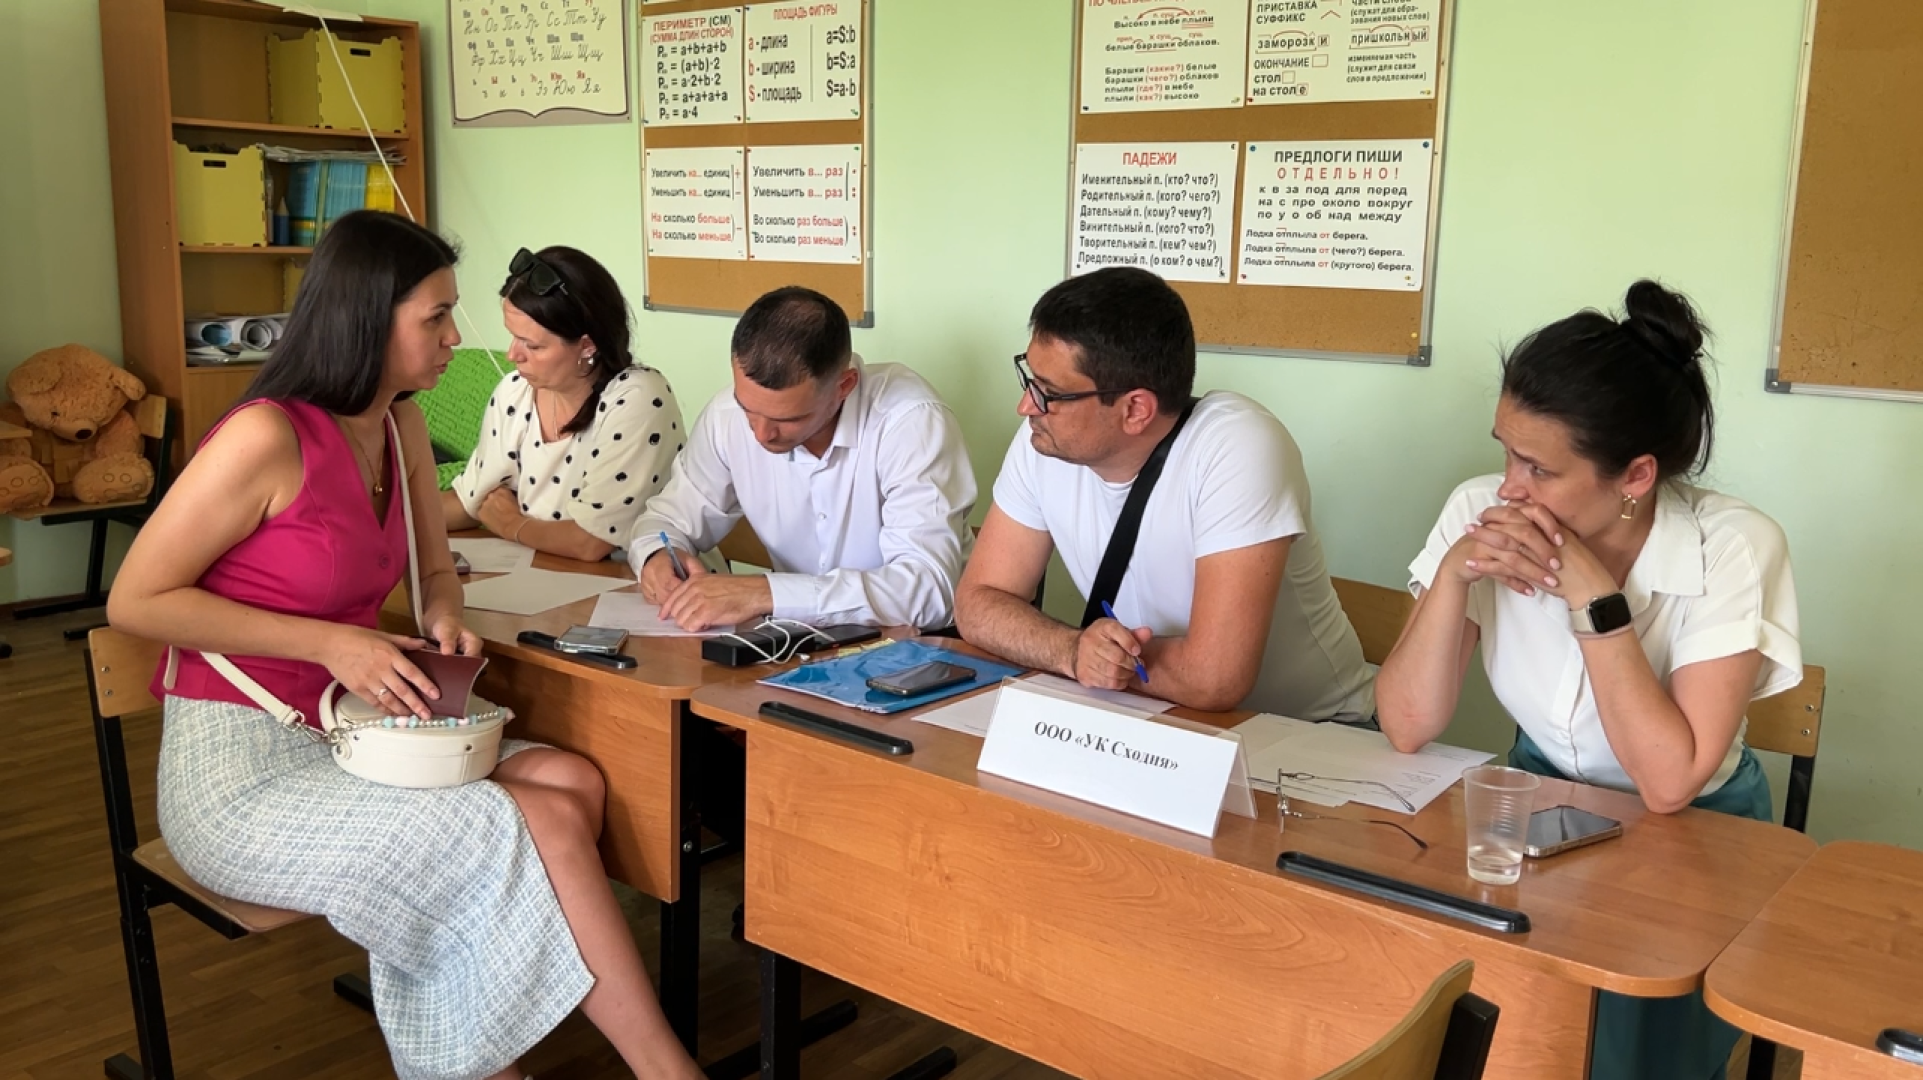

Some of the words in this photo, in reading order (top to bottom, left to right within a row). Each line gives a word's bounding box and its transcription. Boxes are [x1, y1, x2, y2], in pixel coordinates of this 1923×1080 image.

[774, 9, 807, 20] ПЛОЩАДЬ
[810, 4, 837, 16] ФИГУРЫ
[1257, 1, 1317, 12] ПРИСТАВКА
[654, 18, 706, 31] ПЕРИМЕТР
[709, 15, 732, 27] (СМ)
[1257, 13, 1305, 24] СУФФИКС
[650, 34, 677, 45] (СУММА
[679, 32, 699, 42] ДЛИН
[701, 27, 733, 38] СТОРОН)
[749, 36, 754, 50] a
[761, 35, 788, 51] длина
[749, 59, 754, 76] b
[762, 60, 795, 78] ширина
[1254, 57, 1309, 69] ОКОНЧАНИЕ
[1254, 75, 1281, 83] стол
[749, 85, 755, 102] S
[763, 86, 802, 103] площадь
[1254, 88, 1266, 96] на
[1123, 153, 1177, 168] ПАДЕЖИ
[1274, 151, 1351, 165] ПРЕДЛОГИ
[1356, 151, 1402, 162] ПИШИ
[753, 166, 805, 177] Увеличить
[825, 168, 843, 178] раз
[1082, 174, 1151, 185] Именительный
[1165, 174, 1189, 187] (кто?
[1192, 174, 1218, 187] что?)
[753, 186, 804, 197] Уменьшить
[825, 188, 842, 199] раз
[1081, 190, 1143, 201] Родительный
[1156, 190, 1186, 203] (кого?
[1189, 190, 1220, 204] чего?)
[1306, 186, 1329, 195] под
[1336, 186, 1360, 195] для
[1367, 187, 1407, 196] перед
[1293, 199, 1315, 208] про
[1368, 200, 1413, 210] вокруг
[651, 213, 661, 222] На
[664, 214, 695, 223] сколько
[697, 214, 730, 224] больше
[1080, 205, 1131, 218] Дательный
[1144, 206, 1176, 220] (кому?
[1179, 207, 1211, 220] чему?)
[1279, 212, 1285, 220] у
[1306, 210, 1321, 219] об
[1329, 213, 1351, 222] над
[1359, 213, 1402, 223] между
[754, 214, 763, 224] Во
[765, 215, 795, 226] сколько
[797, 217, 810, 228] раз
[812, 215, 843, 227] больше
[1080, 221, 1143, 232] Винительный
[1156, 223, 1186, 235] (кого?
[1188, 223, 1214, 236] что?)
[1246, 229, 1273, 238] Лодка
[1333, 232, 1368, 241] берега.
[653, 230, 662, 239] На
[664, 231, 696, 240] сколько
[698, 232, 731, 242] меньше
[754, 233, 764, 243] Во
[766, 234, 796, 244] сколько
[798, 236, 811, 247] раз
[813, 236, 843, 246] меньше
[1080, 236, 1146, 249] Творительный
[1149, 241, 1157, 249] п.
[1159, 239, 1186, 251] (кем?
[1189, 240, 1216, 253] чем?)
[1245, 244, 1273, 253] Лодка
[1276, 246, 1316, 254] отплыла
[1332, 247, 1366, 257] (чего?)
[1369, 248, 1405, 257] берега.
[1078, 252, 1137, 264] Предложный
[1150, 255, 1159, 267] (о
[1162, 256, 1185, 265] ком?
[1195, 257, 1222, 269] чем?)
[1244, 258, 1272, 266] Лодка
[1331, 261, 1375, 270] (крутого)
[1378, 261, 1414, 271] берега.
[1035, 721, 1071, 742] ООО
[1075, 733, 1108, 752] «УК
[1111, 741, 1178, 770] Сходня»
